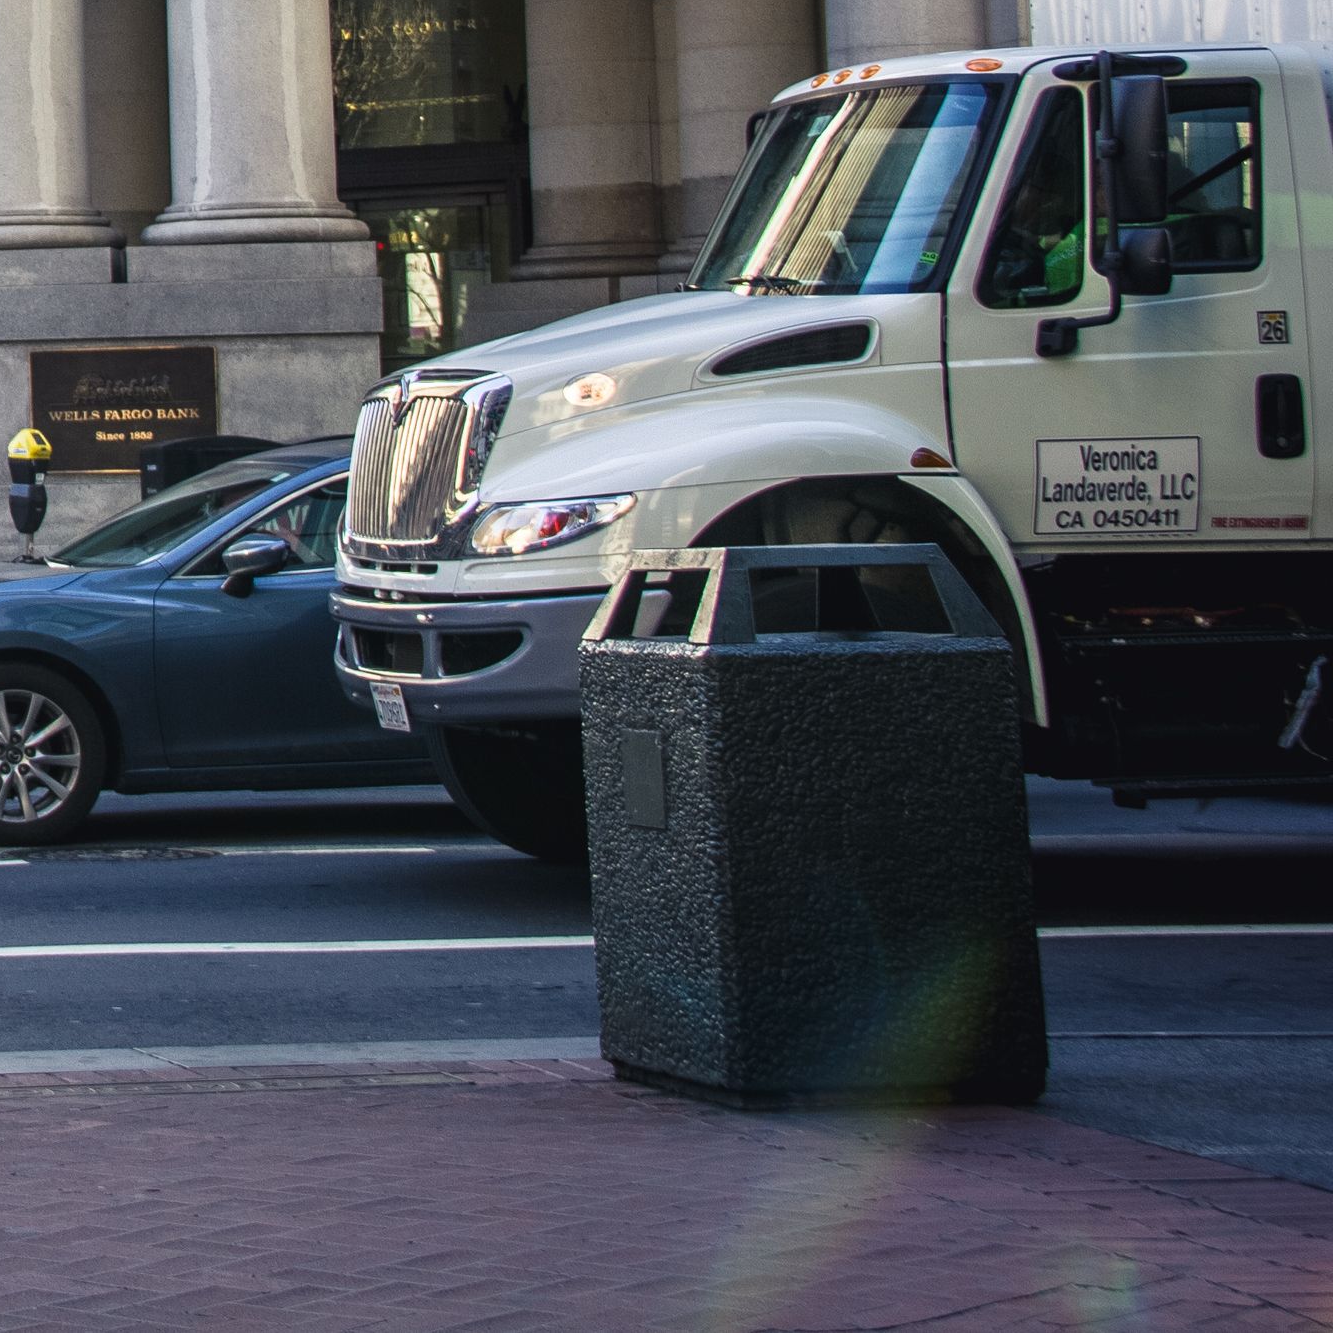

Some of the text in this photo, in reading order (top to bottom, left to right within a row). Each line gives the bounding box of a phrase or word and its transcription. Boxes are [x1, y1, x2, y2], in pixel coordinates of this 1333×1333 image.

[1261, 320, 1284, 341] 26
[49, 408, 200, 422] WELLS FARGO BANK
[95, 431, 154, 441] Since 1852
[1080, 443, 1158, 471] Veronica
[1041, 472, 1196, 505] Landaverde, LLC
[1054, 508, 1180, 529] CA 0450411
